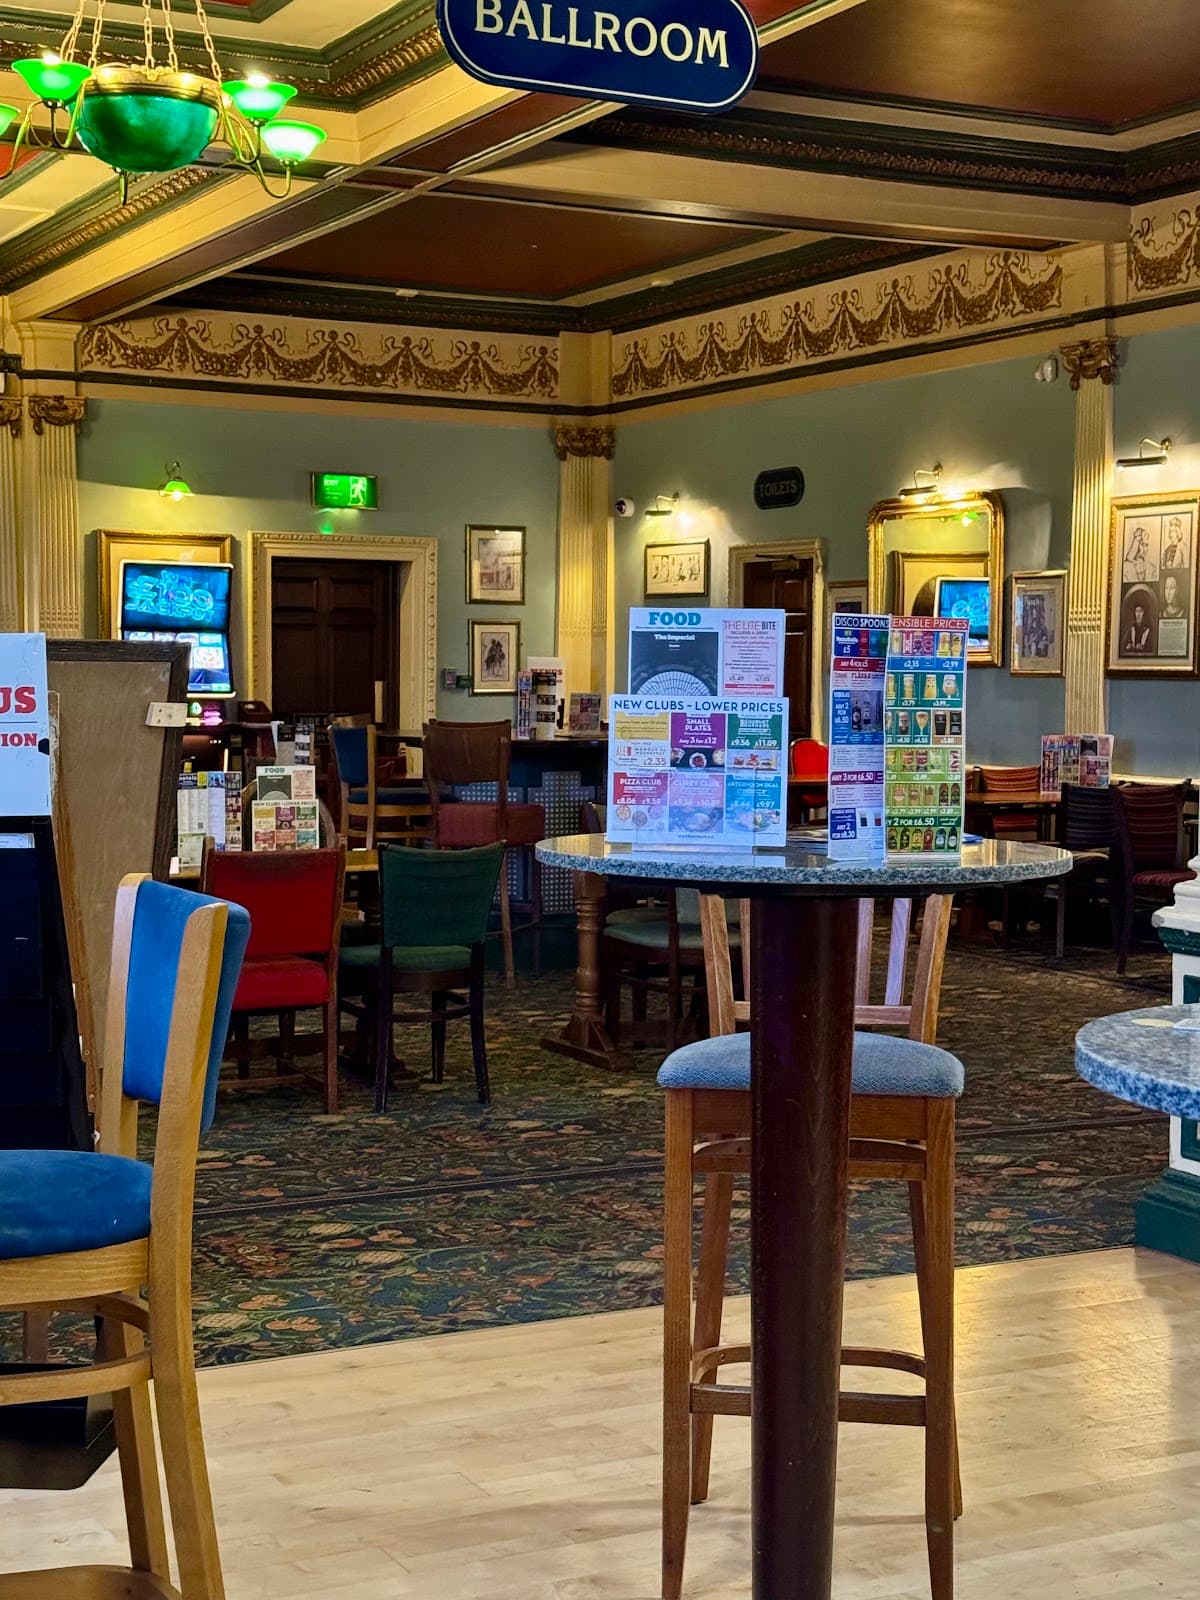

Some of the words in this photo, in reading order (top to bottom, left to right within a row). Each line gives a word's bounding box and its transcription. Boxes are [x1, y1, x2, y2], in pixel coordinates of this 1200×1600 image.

[475, 0, 730, 68] BALLROOM
[759, 480, 797, 497] TOILETS
[124, 600, 215, 622] JACKPOT
[648, 612, 701, 625] FOOD
[836, 617, 859, 627] DISCO
[860, 618, 889, 628] SPOONS
[723, 620, 742, 630] THE
[743, 620, 761, 631] LITE
[761, 621, 777, 631] BITE
[893, 619, 931, 628] ENSIBLE
[933, 619, 968, 630] PRICES
[0, 687, 36, 713] US
[614, 700, 642, 710] NEW
[645, 700, 684, 710] CLUBS
[695, 701, 739, 712] LOWER
[741, 702, 783, 712] PRICES
[684, 724, 712, 732] PLATES
[1, 733, 37, 746] ION
[690, 736, 696, 744] 3
[704, 736, 718, 745] £12
[641, 778, 662, 786] CLUB
[831, 774, 842, 782] ANY
[842, 773, 848, 782] 3
[857, 772, 874, 782] £6.50
[756, 800, 775, 808] £9.97
[893, 818, 899, 826] 2
[914, 818, 935, 826] £6.50
